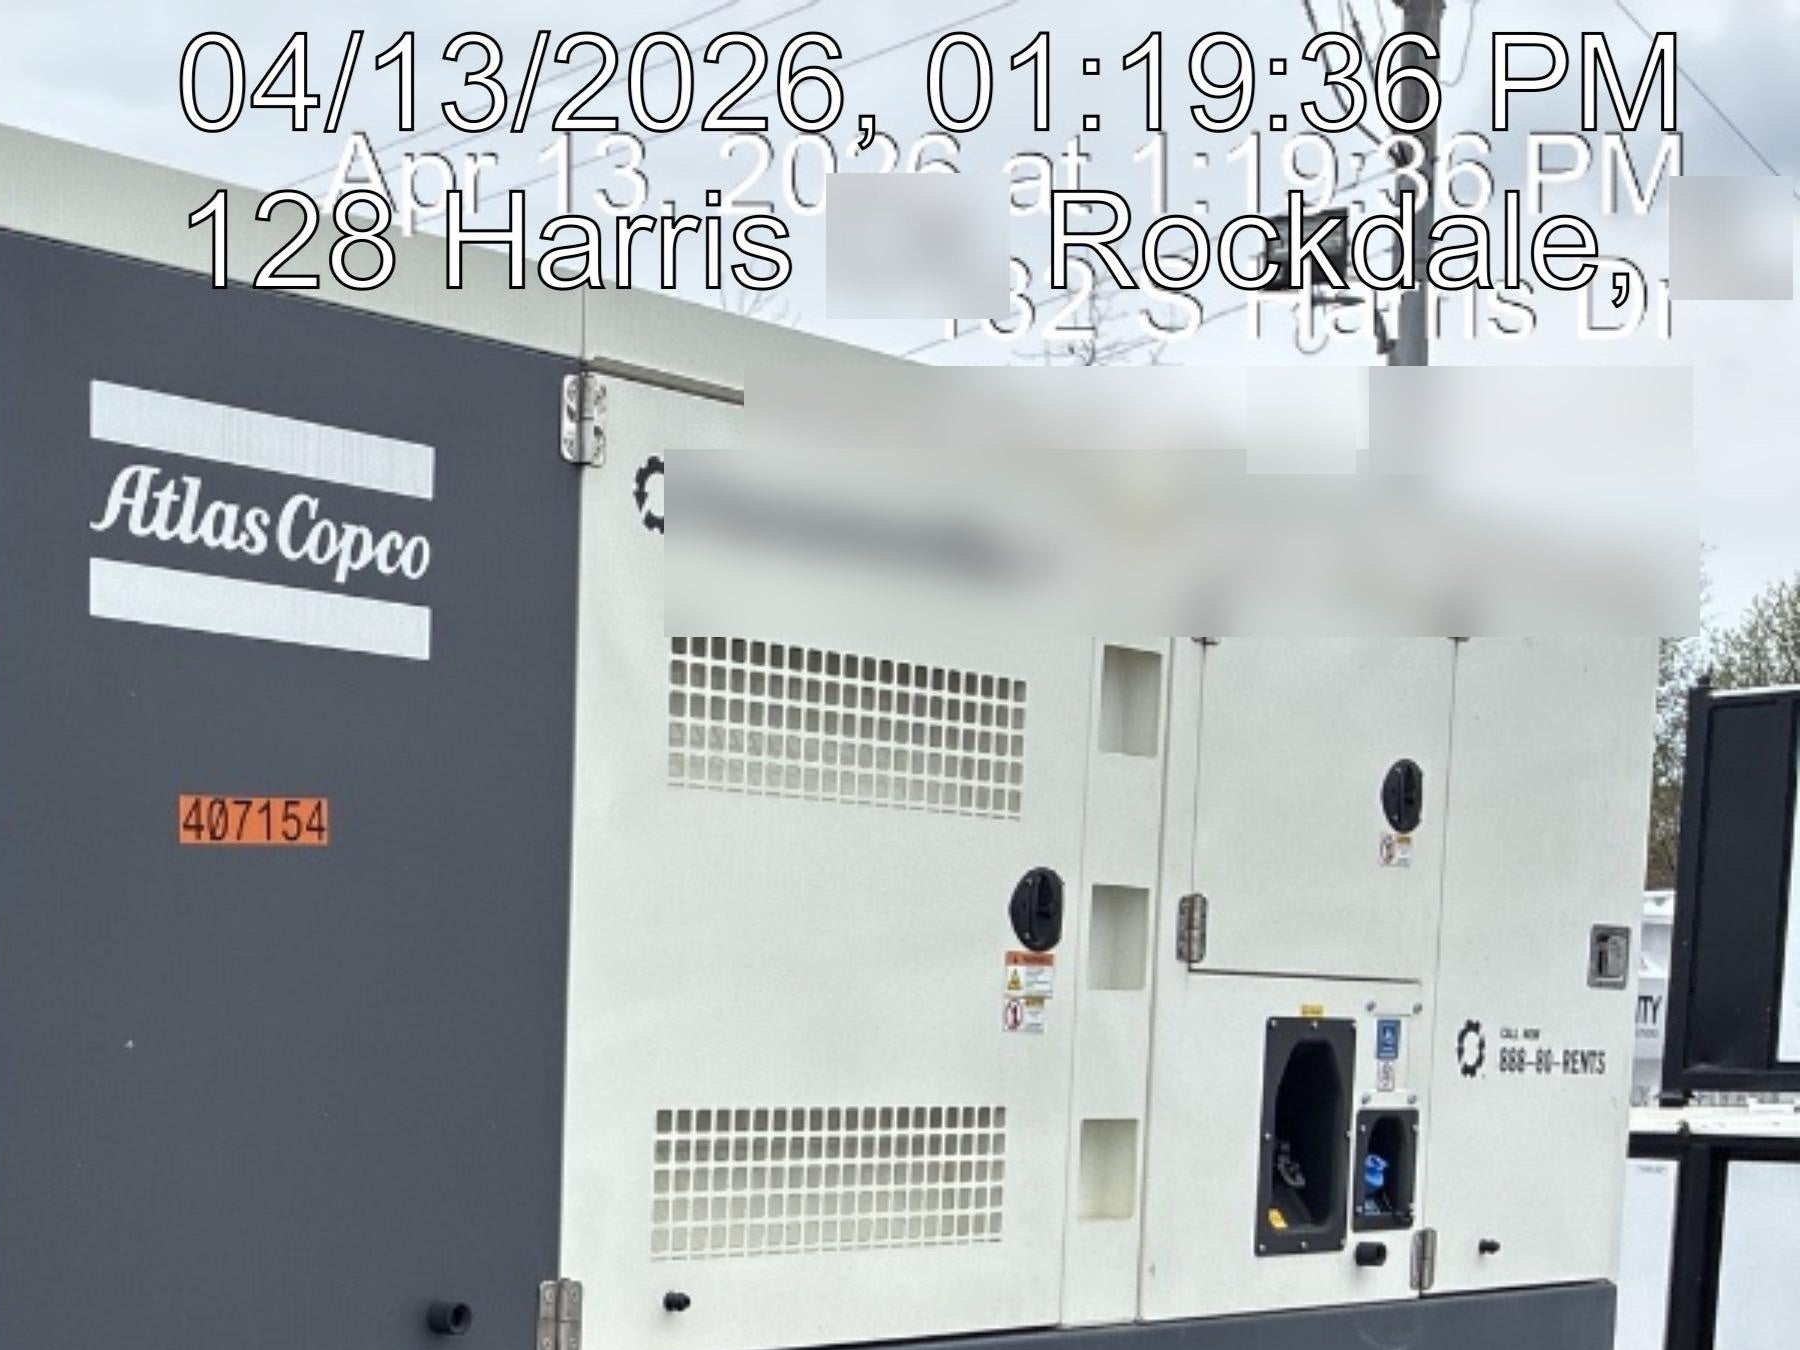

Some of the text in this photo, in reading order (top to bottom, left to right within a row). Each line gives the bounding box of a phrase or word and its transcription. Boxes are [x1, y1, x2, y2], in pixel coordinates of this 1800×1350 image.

[89, 464, 431, 583] Atlas Copco
[182, 798, 326, 841] 407154
[1499, 1047, 1606, 1075] 888-80-RENTS
